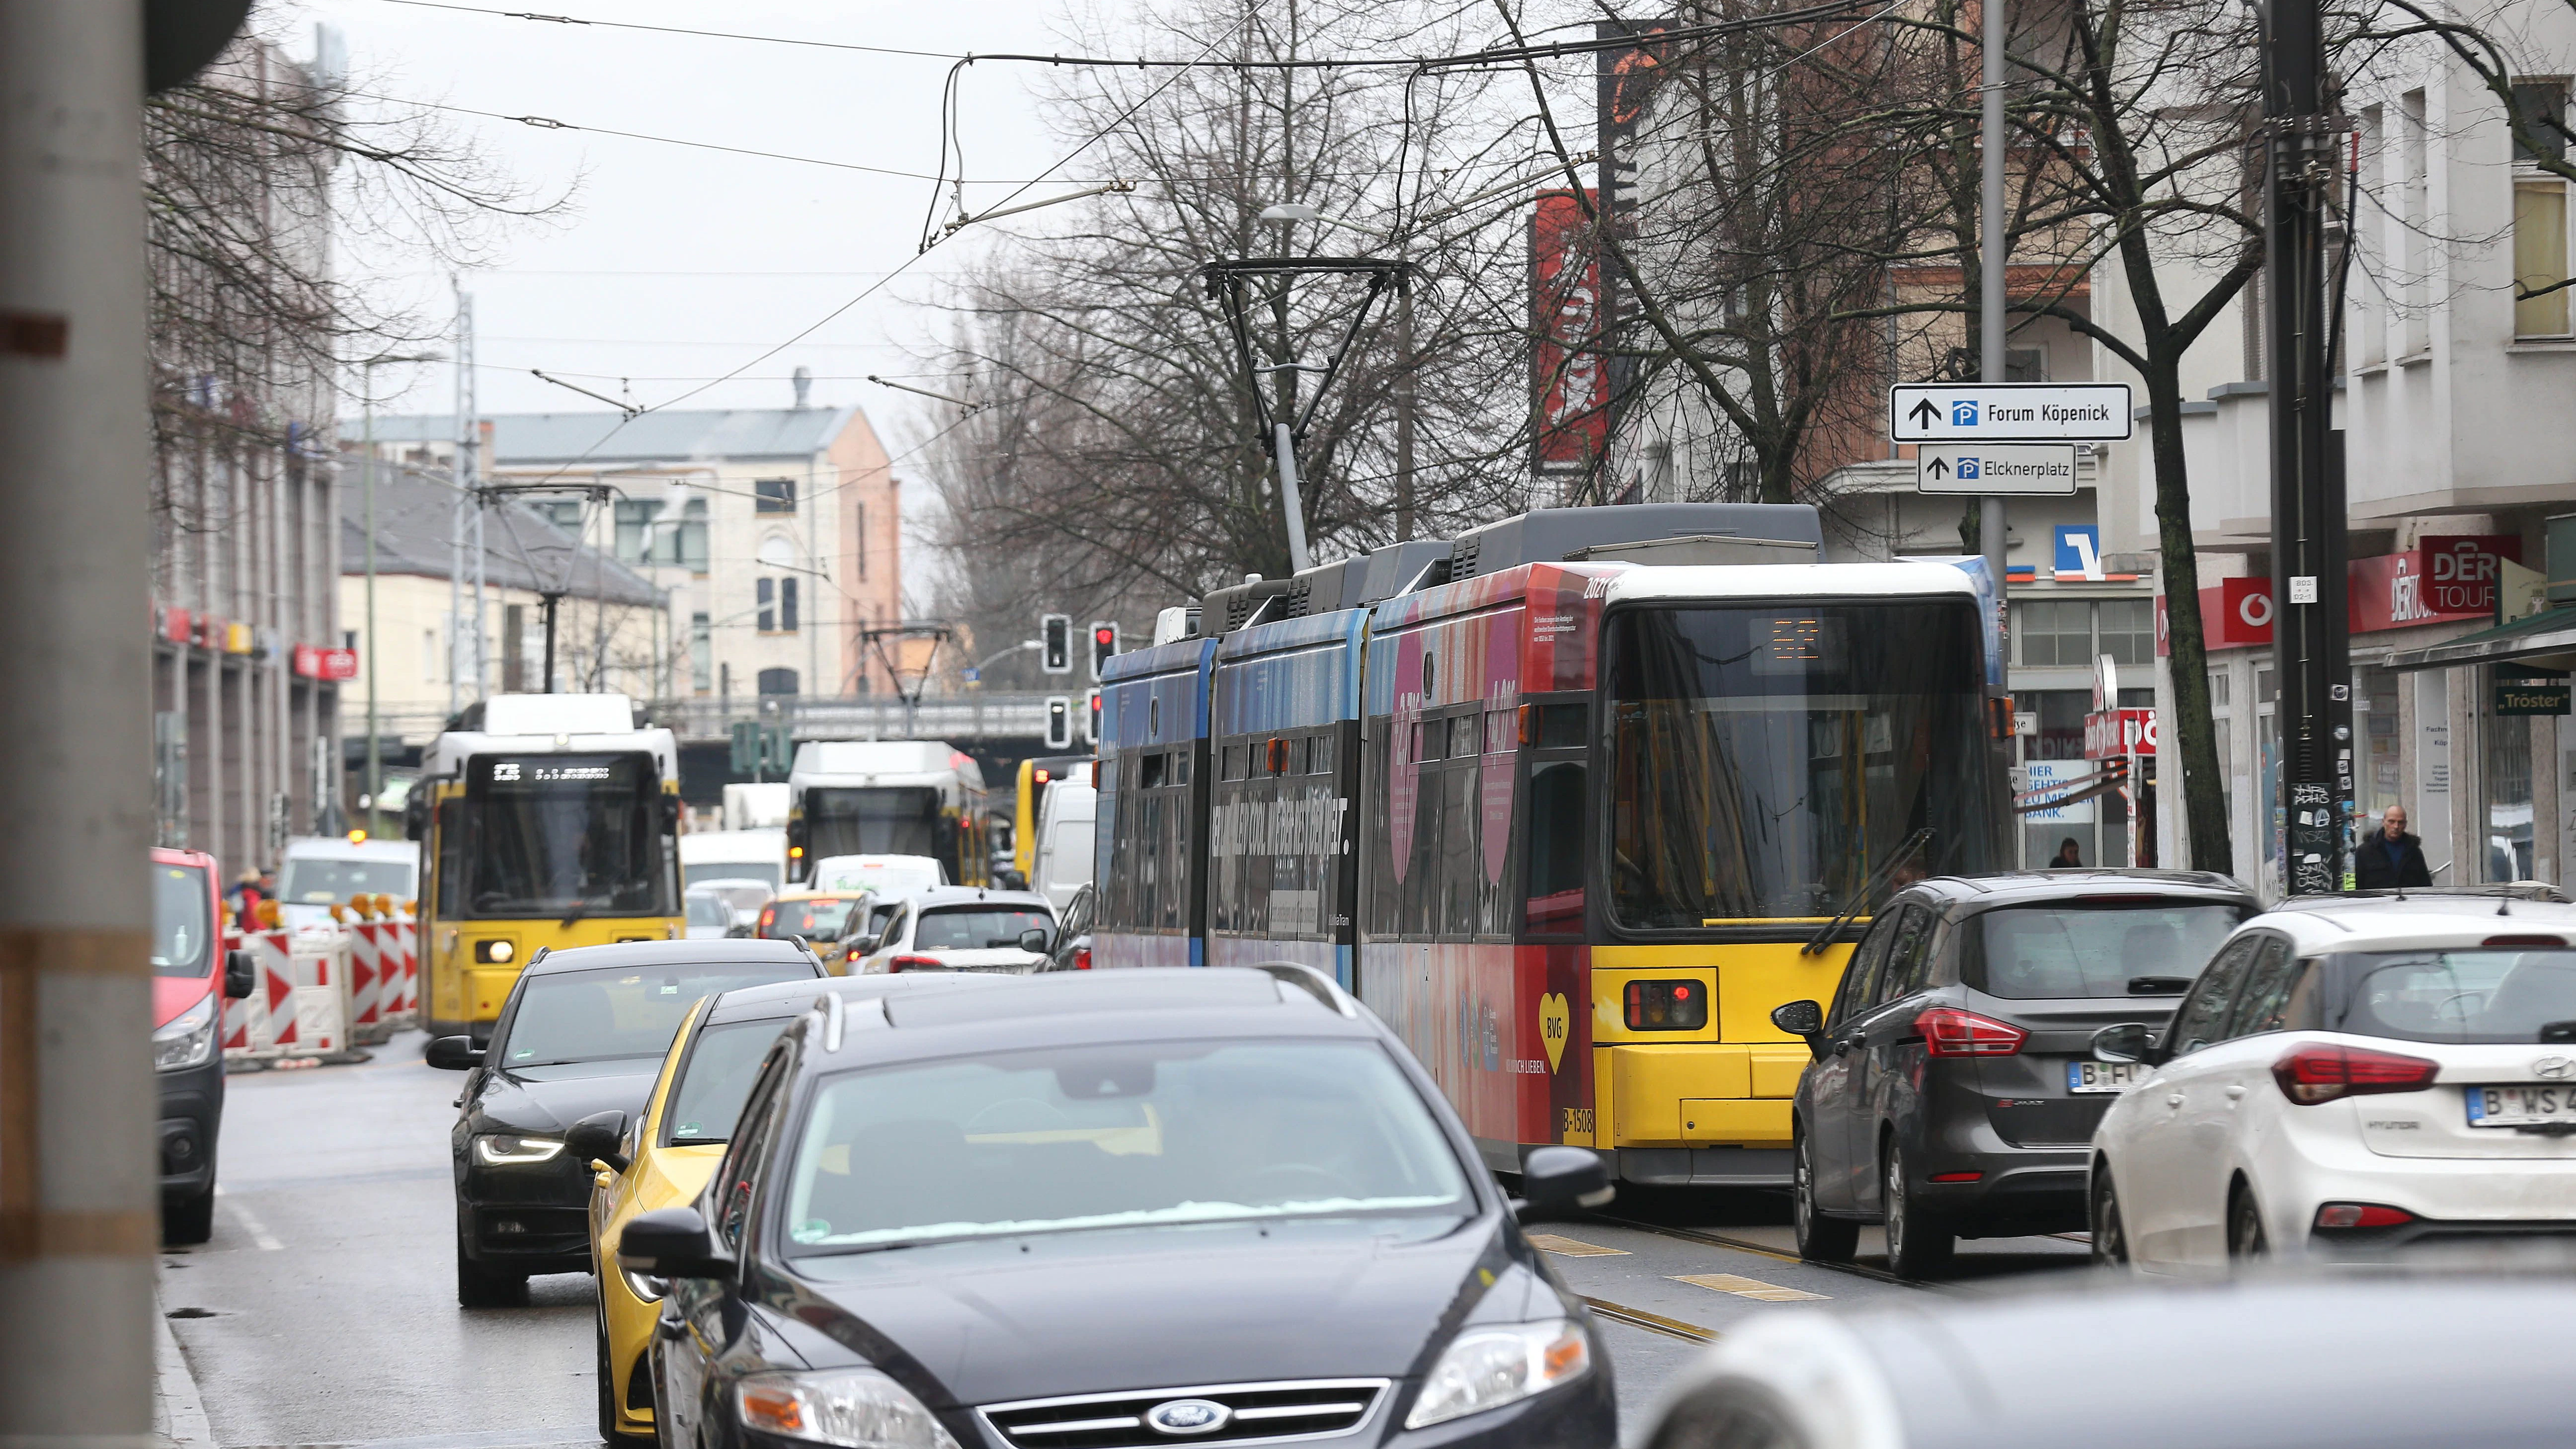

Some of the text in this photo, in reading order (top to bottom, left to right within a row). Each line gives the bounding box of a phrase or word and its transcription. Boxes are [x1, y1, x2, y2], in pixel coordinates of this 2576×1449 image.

[1989, 404, 2034, 421] Forum
[2042, 403, 2110, 425] Köpenick
[1985, 461, 2069, 480] Elcknerplatz
[2434, 553, 2497, 581] DER
[1584, 577, 1611, 600] 2021
[1772, 620, 1819, 659] 62
[2025, 806, 2065, 818] BANK.
[1547, 1017, 1562, 1039] BVG
[1526, 1060, 1546, 1074] LIEBEN.
[1563, 1109, 1593, 1133] B-1508
